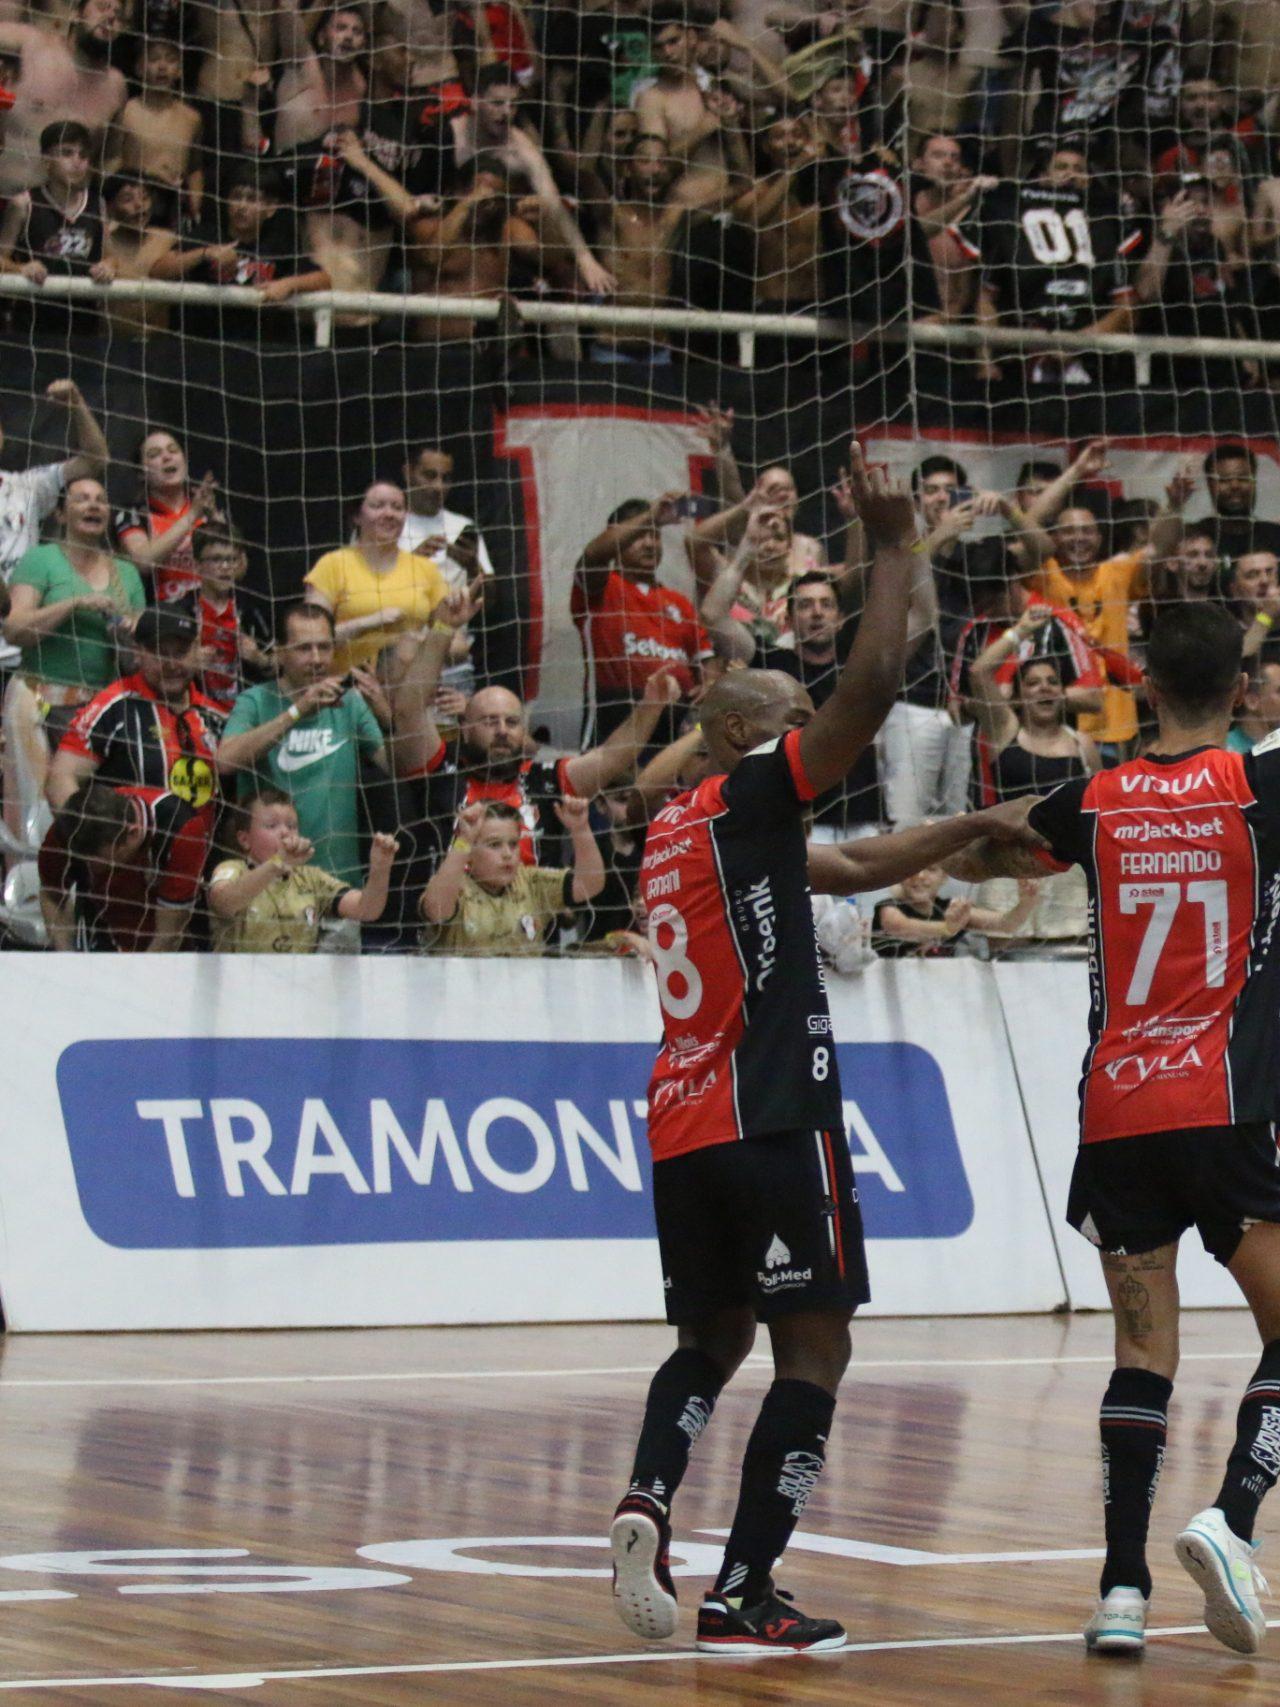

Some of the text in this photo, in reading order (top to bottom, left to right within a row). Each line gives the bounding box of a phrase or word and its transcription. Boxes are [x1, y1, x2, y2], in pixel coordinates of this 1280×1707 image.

[1022, 209, 1095, 267] 01
[288, 729, 333, 752] NIKE
[1121, 851, 1222, 875] FERNANDO
[648, 903, 703, 1020] 8
[1119, 880, 1228, 1006] 71
[812, 1046, 829, 1082] 8
[136, 1097, 906, 1199] TRAMONA
